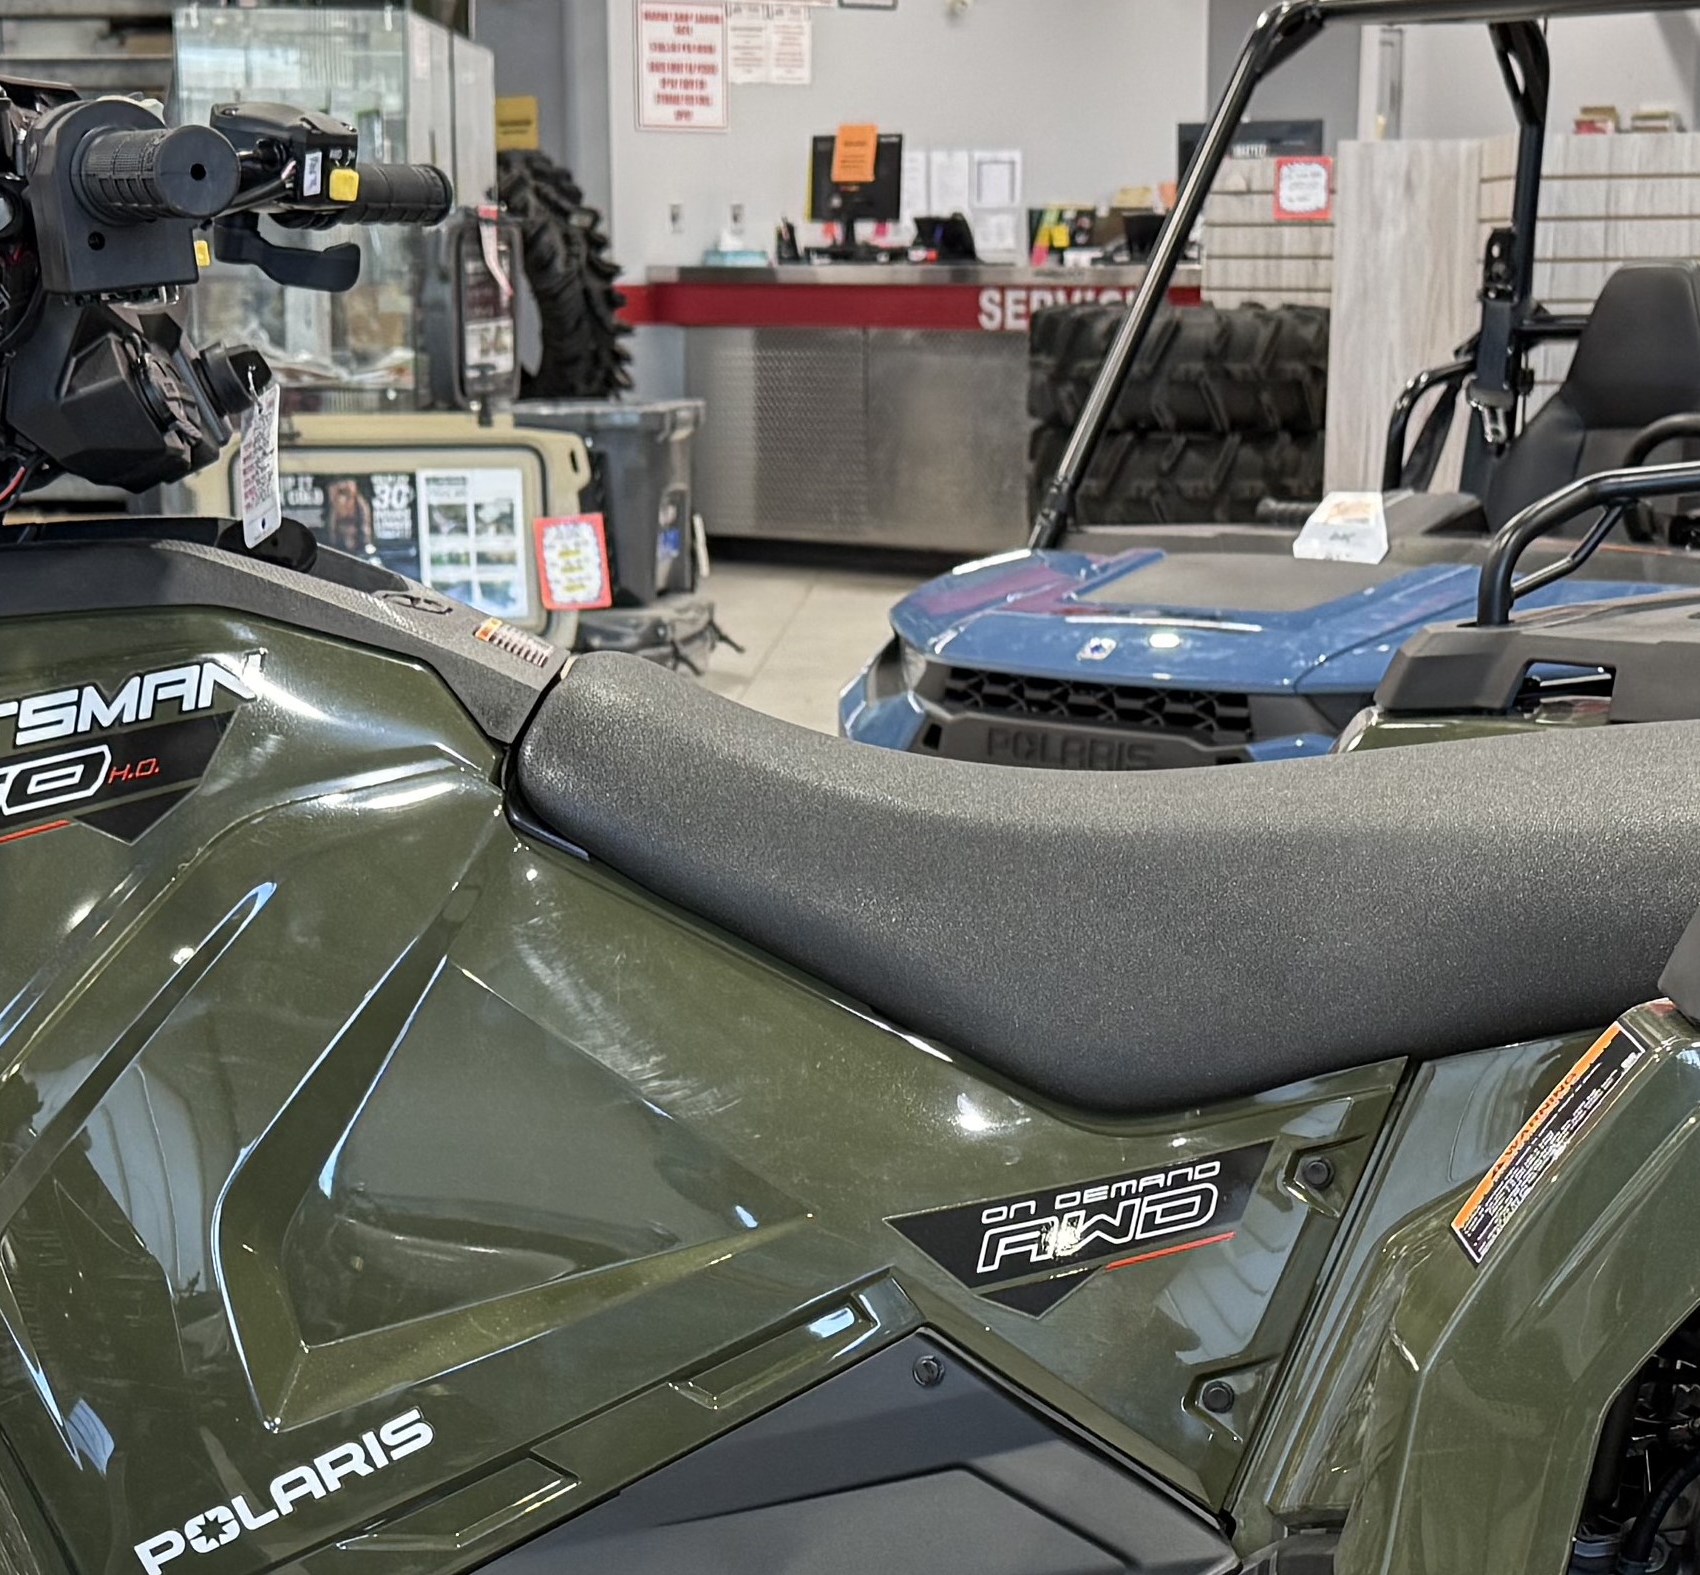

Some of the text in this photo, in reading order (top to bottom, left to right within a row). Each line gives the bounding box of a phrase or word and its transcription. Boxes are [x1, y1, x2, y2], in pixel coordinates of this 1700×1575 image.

[108, 757, 162, 786] H.O.
[1503, 1071, 1580, 1157] WARNING
[976, 1181, 1219, 1273] AWD
[980, 1160, 1221, 1225] ON DEMAND
